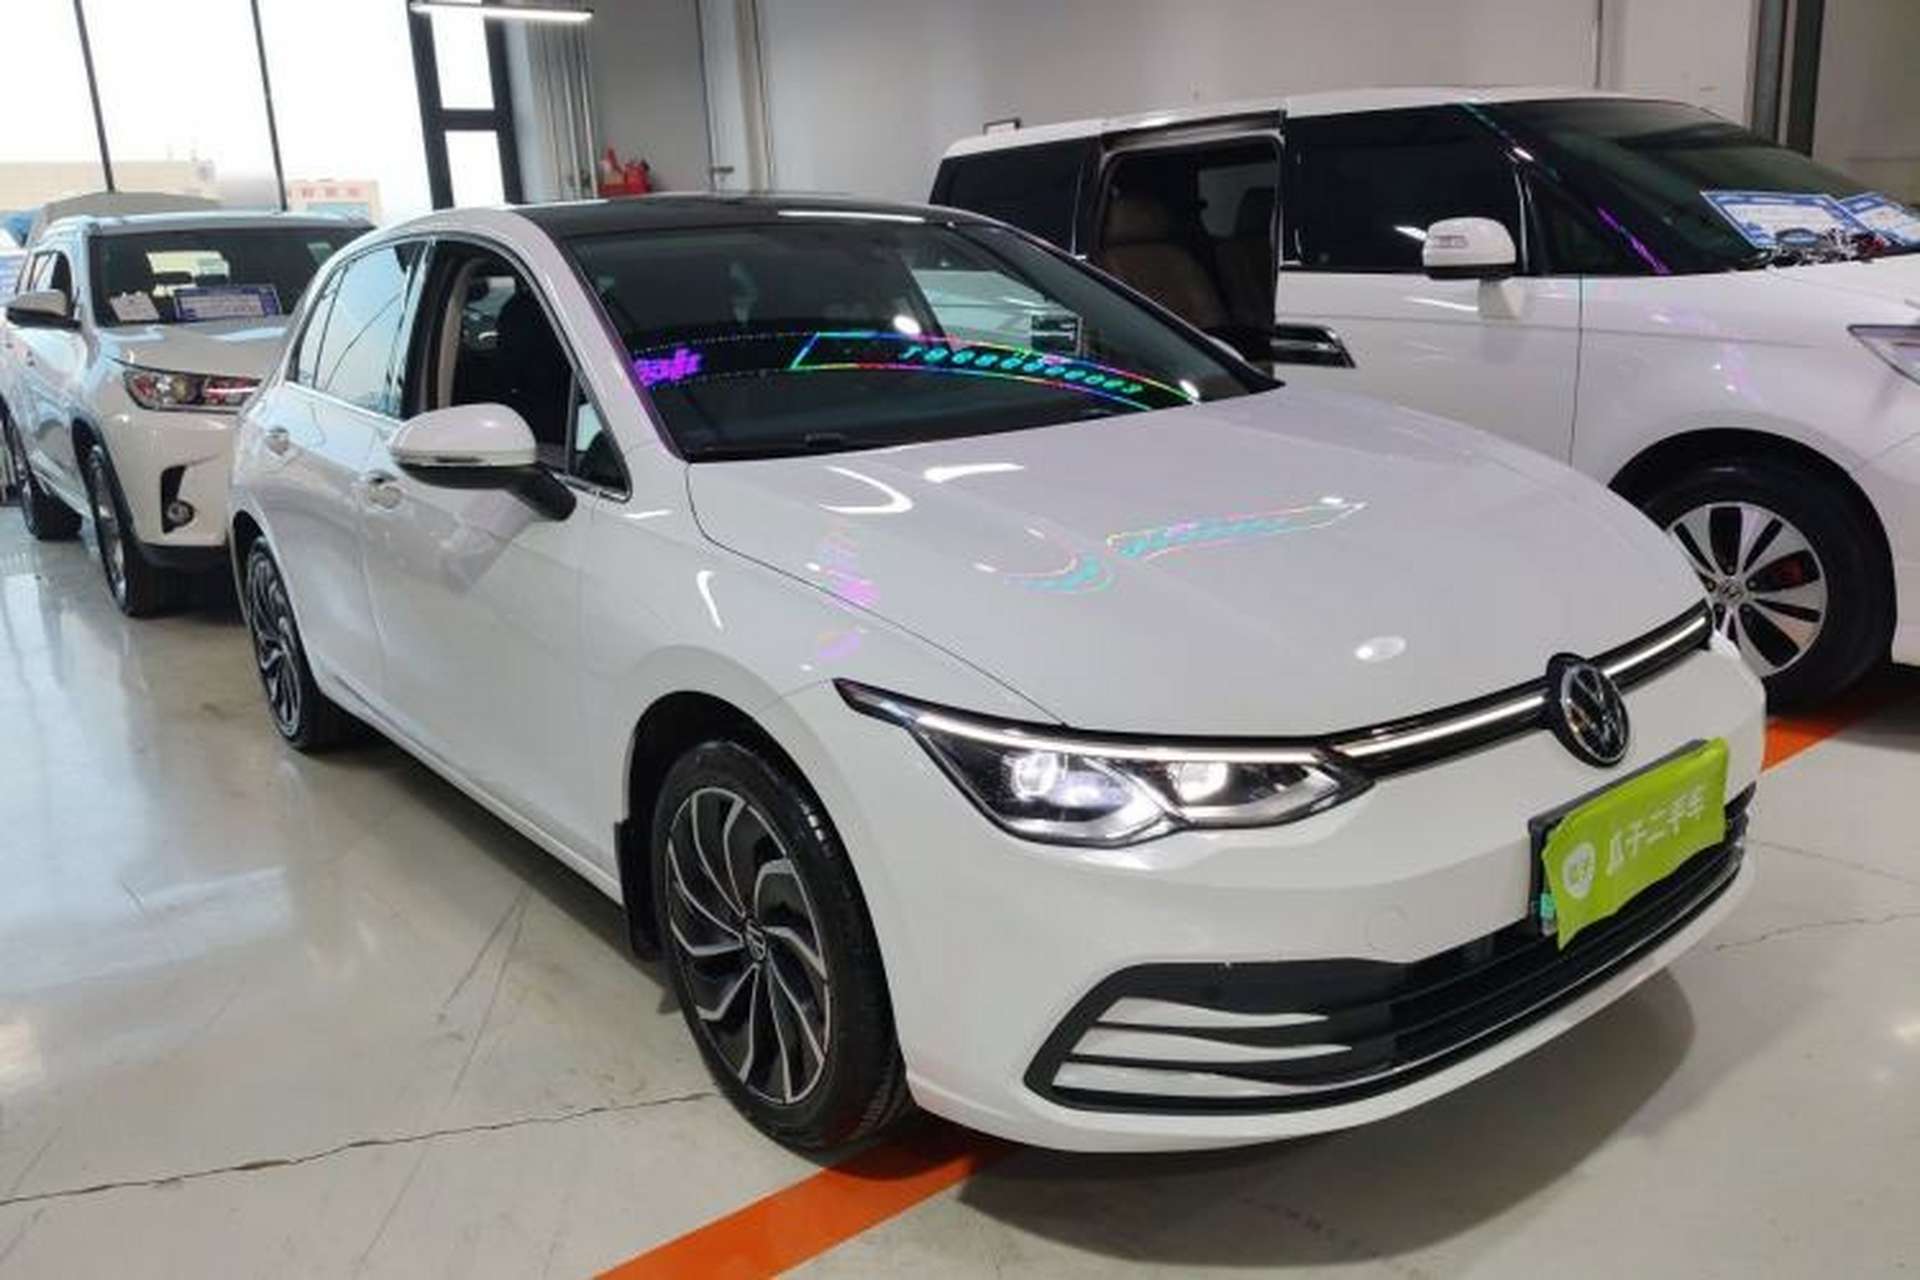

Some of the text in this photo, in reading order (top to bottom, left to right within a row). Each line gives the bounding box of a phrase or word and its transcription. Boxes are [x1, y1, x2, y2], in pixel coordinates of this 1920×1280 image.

[1605, 785, 1706, 877] 瓜子二手车
